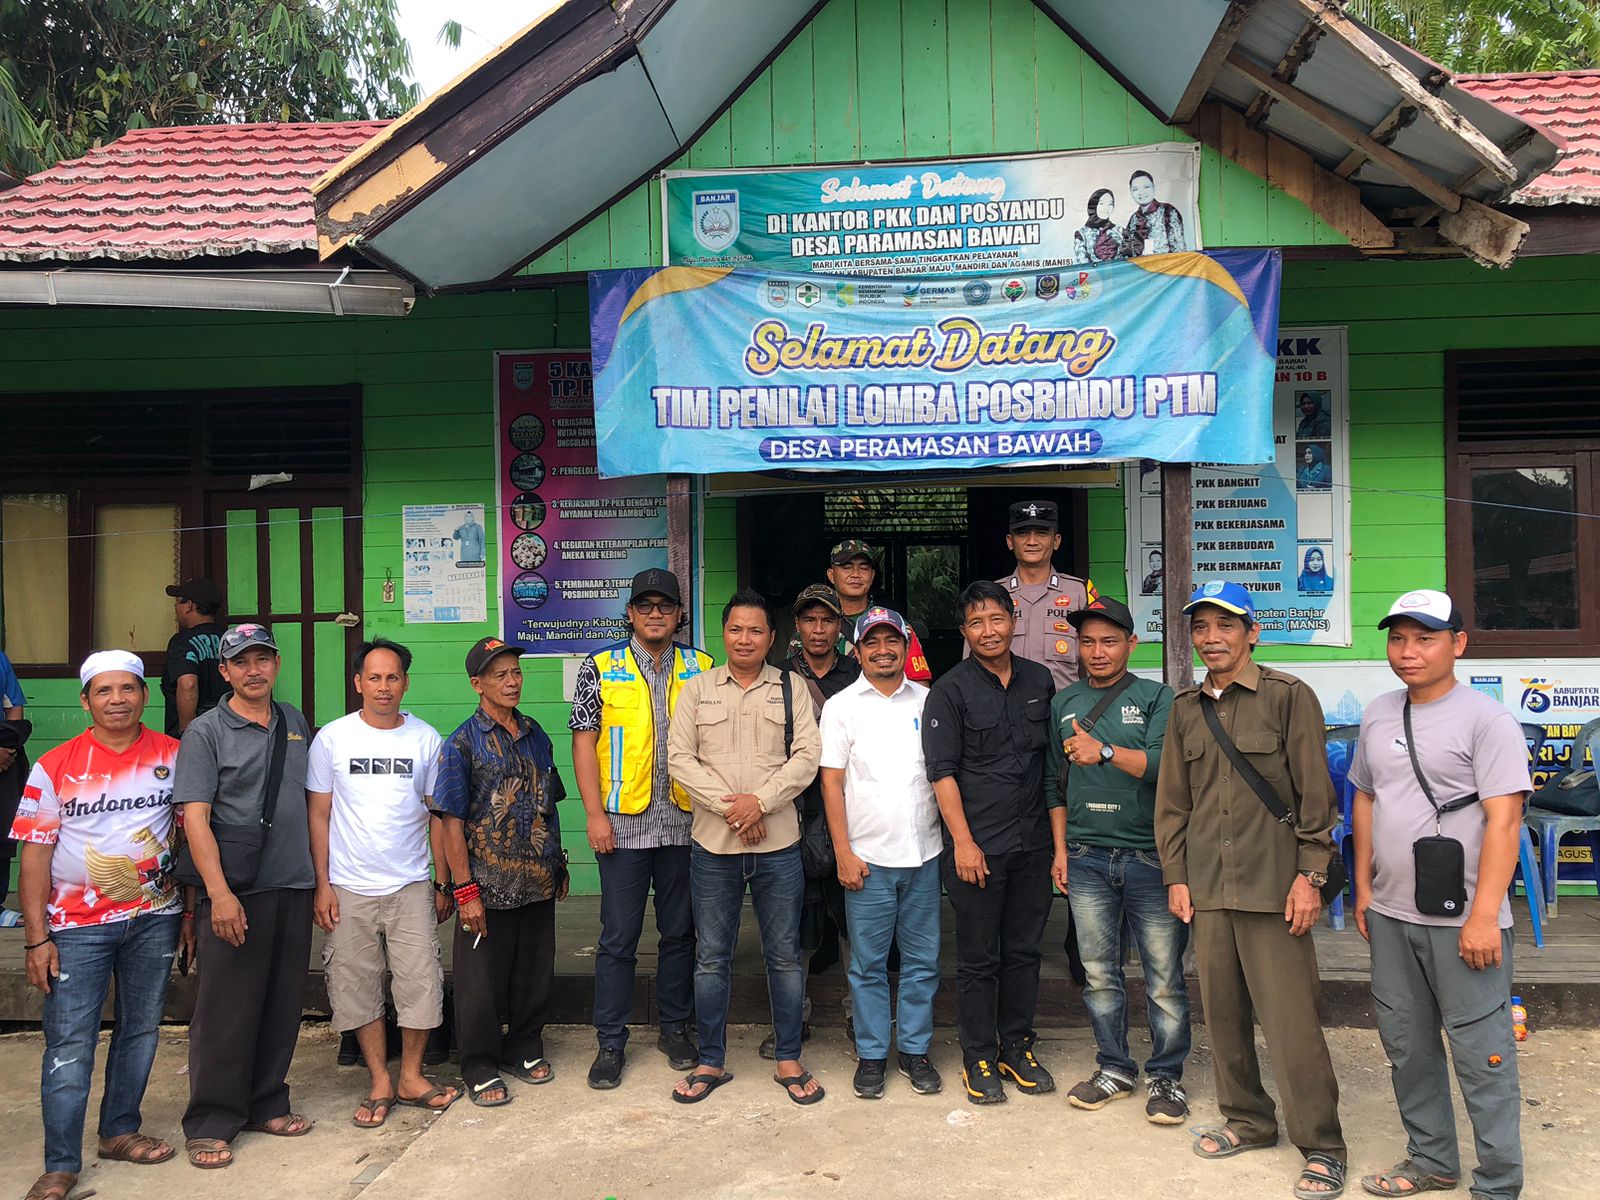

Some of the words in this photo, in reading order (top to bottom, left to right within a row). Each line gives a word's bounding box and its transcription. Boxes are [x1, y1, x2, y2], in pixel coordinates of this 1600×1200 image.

[821, 176, 917, 203] Selamat
[921, 172, 1006, 201] Datang
[700, 194, 731, 203] BANJAR
[767, 213, 788, 234] DI
[792, 210, 869, 233] KANTOR
[873, 207, 913, 230] PKK
[916, 204, 957, 226] DAN
[960, 198, 1065, 224] POSYANDU
[791, 235, 839, 258] DESA
[844, 228, 963, 255] PARAMASAN
[967, 223, 1041, 248] BAWAH
[812, 260, 833, 270] MARI
[834, 258, 853, 268] KITA
[854, 256, 917, 267] BERSAMA-SAMA
[918, 254, 970, 264] TINGKATKAN
[972, 251, 1019, 260] PELAYANAN
[847, 267, 893, 276] KABUPATEN
[895, 265, 927, 275] BANJAR
[929, 263, 952, 272] MAJU,
[955, 262, 989, 271] MANDIRI
[991, 261, 1008, 269] DAN
[1010, 260, 1041, 268] AGAMIS
[1043, 258, 1073, 267] (MANIS)
[920, 287, 956, 295] GERMAS
[747, 320, 937, 376] Selamat
[931, 316, 1116, 377] Datang
[1277, 337, 1322, 356] KK
[550, 362, 562, 378] 5
[566, 361, 593, 378] KA
[1275, 372, 1291, 382] AN
[1294, 372, 1313, 382] 10
[1317, 371, 1328, 381] B
[549, 379, 578, 397] TP.
[652, 386, 711, 429] TIM
[717, 384, 838, 429] PENILAI
[846, 383, 959, 428] LOMBA
[966, 375, 1137, 424] POSBINDU
[1143, 372, 1217, 417] PTM
[557, 417, 593, 427] KERJASAMA
[557, 429, 577, 437] HUTAN
[578, 428, 596, 437] GUNU
[557, 438, 590, 448] UNGGULAN
[770, 438, 833, 459] DESA
[840, 433, 989, 457] PERAMASAN
[998, 432, 1091, 455] BAWAH
[552, 467, 559, 476] 2.
[1195, 479, 1216, 488] PKK
[1217, 478, 1260, 488] BANGKIT
[552, 500, 559, 508] 3.
[559, 498, 599, 508] KERJASAMA
[626, 498, 654, 506] DENGAN
[1196, 499, 1216, 509] PKK
[1218, 498, 1267, 509] BERJUANG
[559, 508, 592, 519] ANYAMAN
[594, 509, 617, 518] BAHAN
[645, 508, 658, 517] DLL
[1194, 521, 1214, 531] PKK
[1216, 519, 1286, 530] BEKERJASAMA
[553, 541, 560, 549] 4.
[561, 540, 595, 549] KEGIATAN
[596, 539, 648, 549] KETERAMPILAN
[649, 538, 668, 547] PEMB
[1196, 541, 1216, 551] PKK
[1218, 541, 1275, 551] BERBUDAYA
[561, 551, 585, 560] ANEKA
[586, 551, 600, 560] KUE
[600, 550, 627, 560] KERING
[1197, 562, 1217, 572] PKK
[1218, 561, 1282, 571] BERMANFAAT
[554, 581, 562, 589] 5.
[562, 580, 604, 589] PEMBINAAN
[611, 579, 633, 588] TEMP
[1240, 583, 1282, 593] SYUKUR
[562, 590, 599, 599] POSBINDU
[600, 589, 619, 599] DESA
[1254, 608, 1286, 619] upaten
[1289, 608, 1325, 619] Banjar
[592, 618, 630, 628] Kabup
[1147, 622, 1163, 631] Ma
[1260, 621, 1284, 631] amis
[1286, 620, 1330, 632] (MANIS)
[517, 631, 544, 642] Maju,
[546, 630, 584, 640] Mandiri
[585, 629, 604, 639] dan
[911, 656, 930, 672] BA
[1553, 687, 1599, 695] KABUPATEN
[1552, 695, 1600, 708] BANJAR
[65, 790, 173, 817] Indonesia
[18, 810, 37, 819] ESIA
